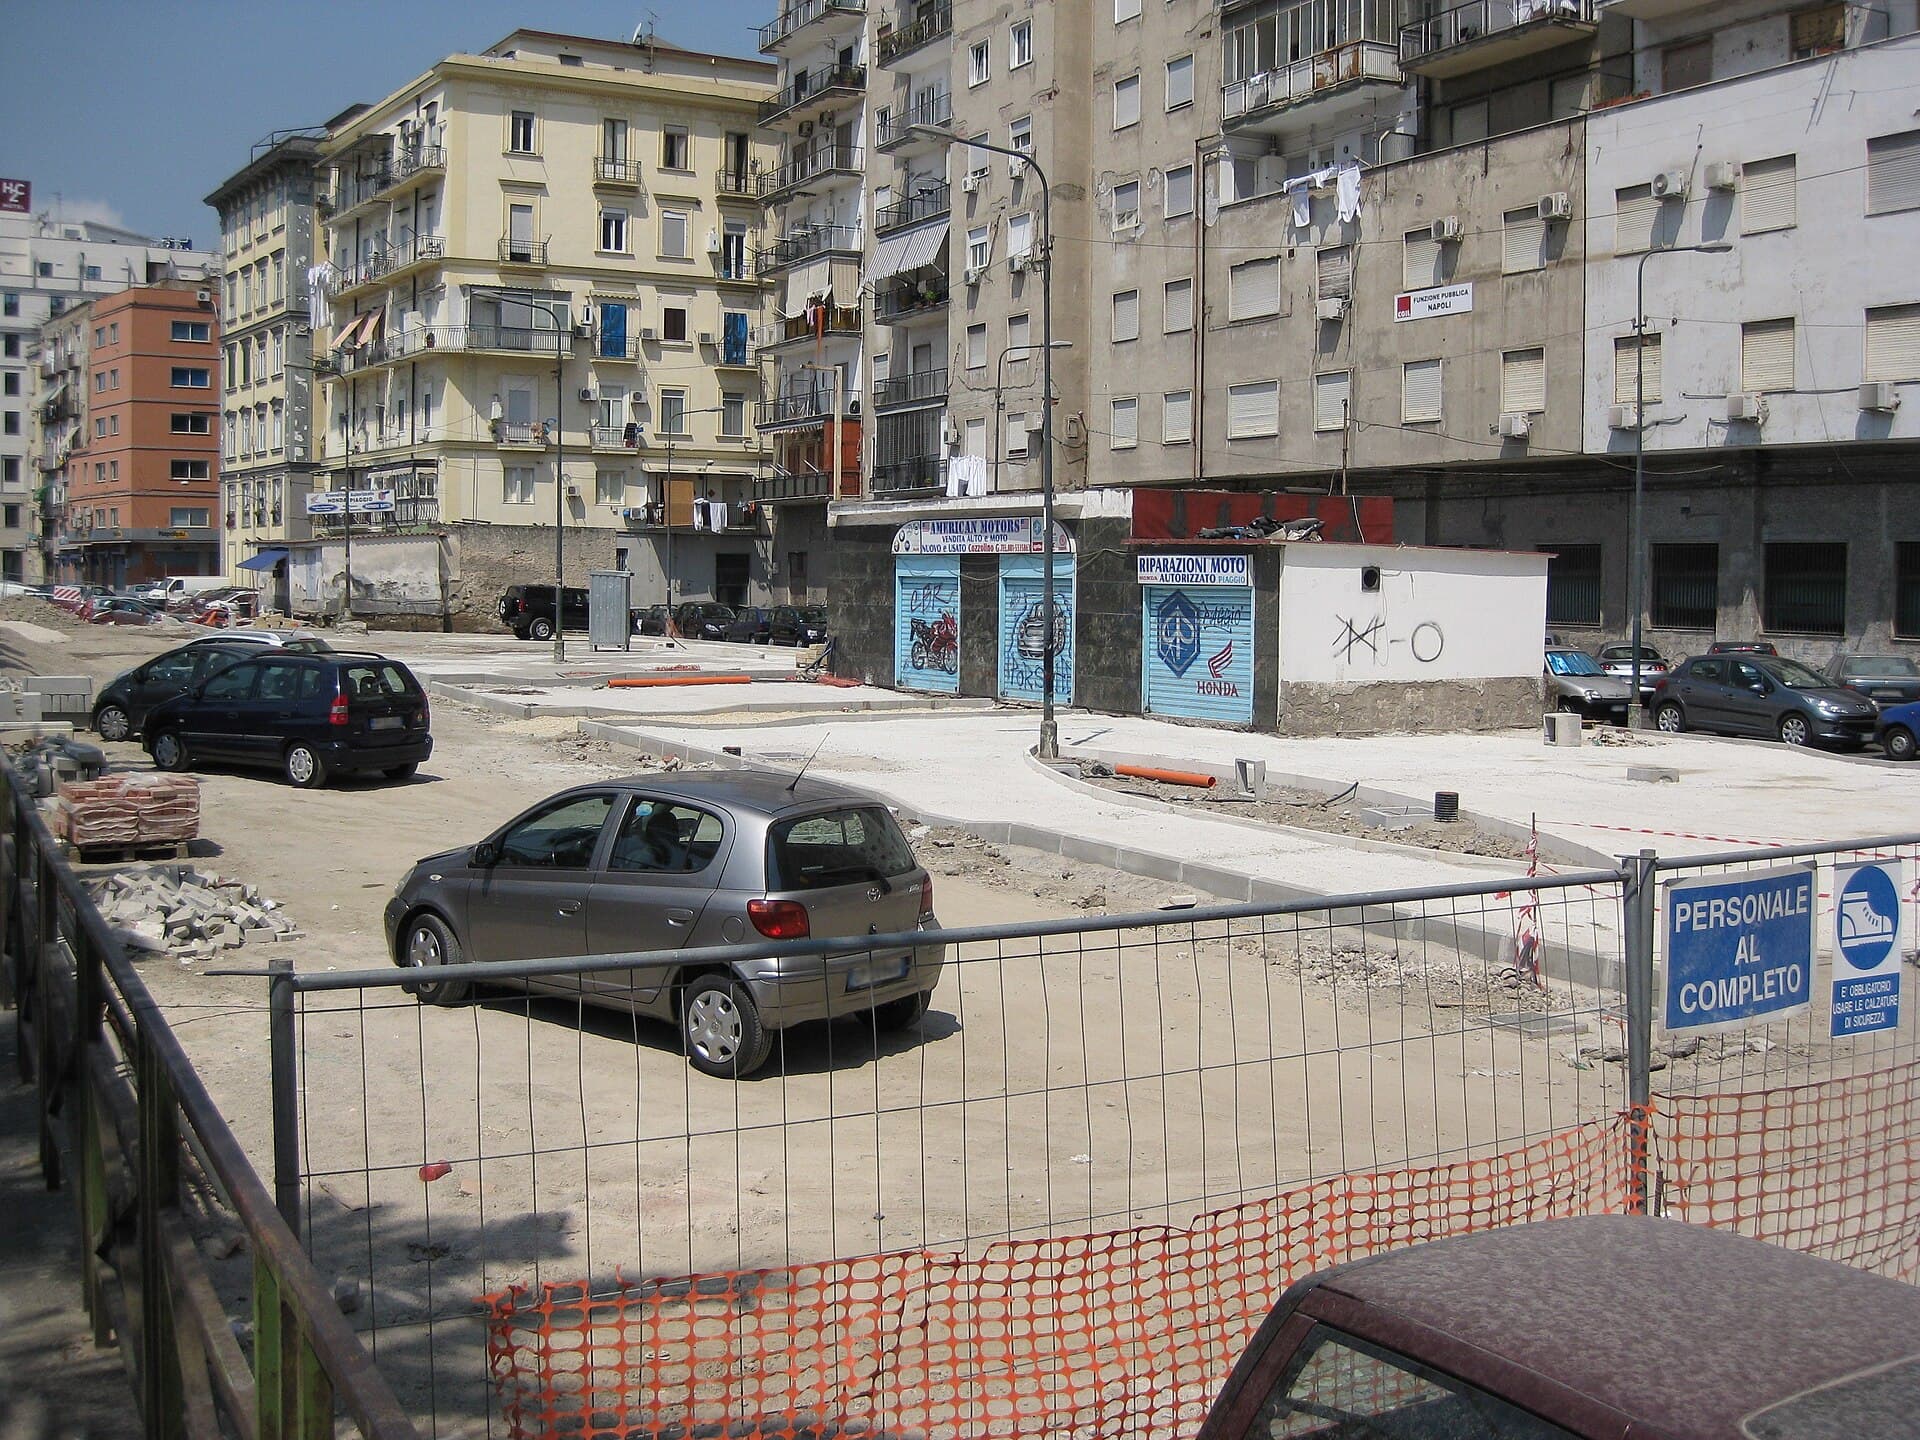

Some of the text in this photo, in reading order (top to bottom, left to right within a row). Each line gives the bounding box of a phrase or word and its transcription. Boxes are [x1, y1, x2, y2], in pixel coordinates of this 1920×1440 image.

[1413, 289, 1468, 304] FUNZIONE PUBBLICA
[1427, 301, 1451, 312] NAPOLI
[930, 519, 1020, 534] AMERICAN MOTORS
[942, 534, 965, 543] VENDITA
[966, 534, 982, 542] AUTO
[990, 534, 1008, 542] MOTO
[948, 543, 966, 552] USATO
[1139, 557, 1245, 573] RIPARAZIONI MOTO
[1160, 573, 1216, 583] AUTORIZZATO
[1218, 575, 1245, 584] PIAGGIO
[1197, 681, 1239, 697] HONDA
[1675, 885, 1808, 933] PERSONALE
[1734, 934, 1761, 966] AL
[1679, 963, 1801, 1014] COMPLETO
[1849, 980, 1891, 997] OBBLIGATORIO
[1833, 994, 1898, 1015] USARE LE CALZATURE
[1844, 1012, 1886, 1028] DI SICUREZZA
